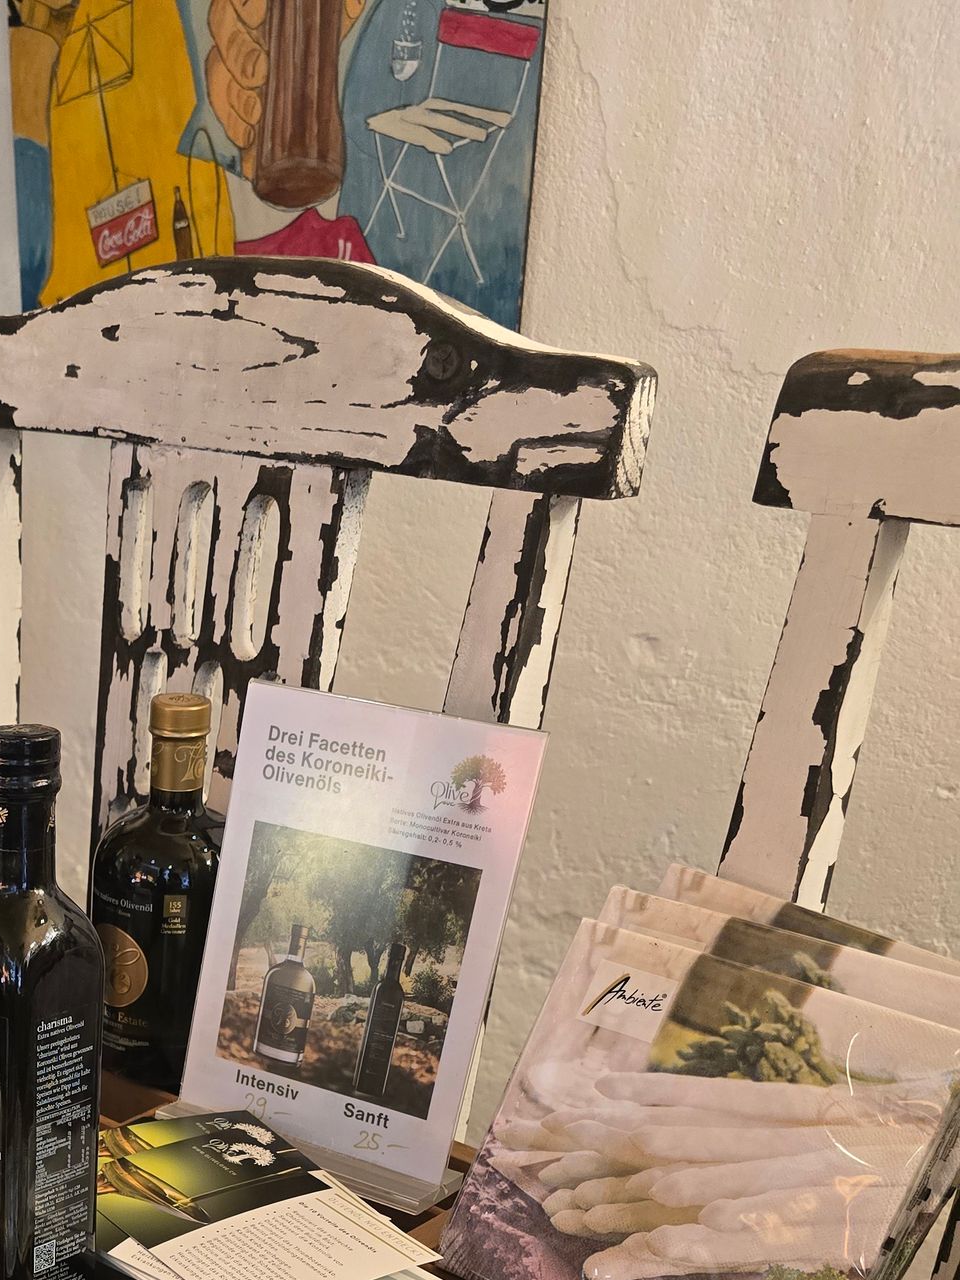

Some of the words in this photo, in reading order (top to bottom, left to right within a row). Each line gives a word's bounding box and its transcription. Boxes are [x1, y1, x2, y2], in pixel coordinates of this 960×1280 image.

[268, 725, 304, 746] Drei
[308, 732, 386, 762] Facetten
[262, 764, 342, 794] Olivenöls
[265, 745, 296, 765] des
[301, 751, 394, 783] Koroneiki-
[415, 811, 442, 822] Olivenöl
[442, 817, 460, 827] Extra
[461, 821, 473, 830] aus
[473, 824, 492, 833] Kreta
[451, 830, 482, 841] Koroneiki
[120, 899, 153, 912] Olivenöl
[582, 972, 664, 1016] Ambiente
[36, 1015, 73, 1034] charisma
[37, 1031, 49, 1041] Extra
[236, 1069, 299, 1100] Intensiv
[343, 1102, 390, 1129] Sanft
[313, 1212, 341, 1228] Vorteile
[336, 1227, 352, 1235] des
[347, 1234, 380, 1253] Olivenöls
[362, 1219, 384, 1231] NEU
[379, 1230, 425, 1257] ENTDECKT
